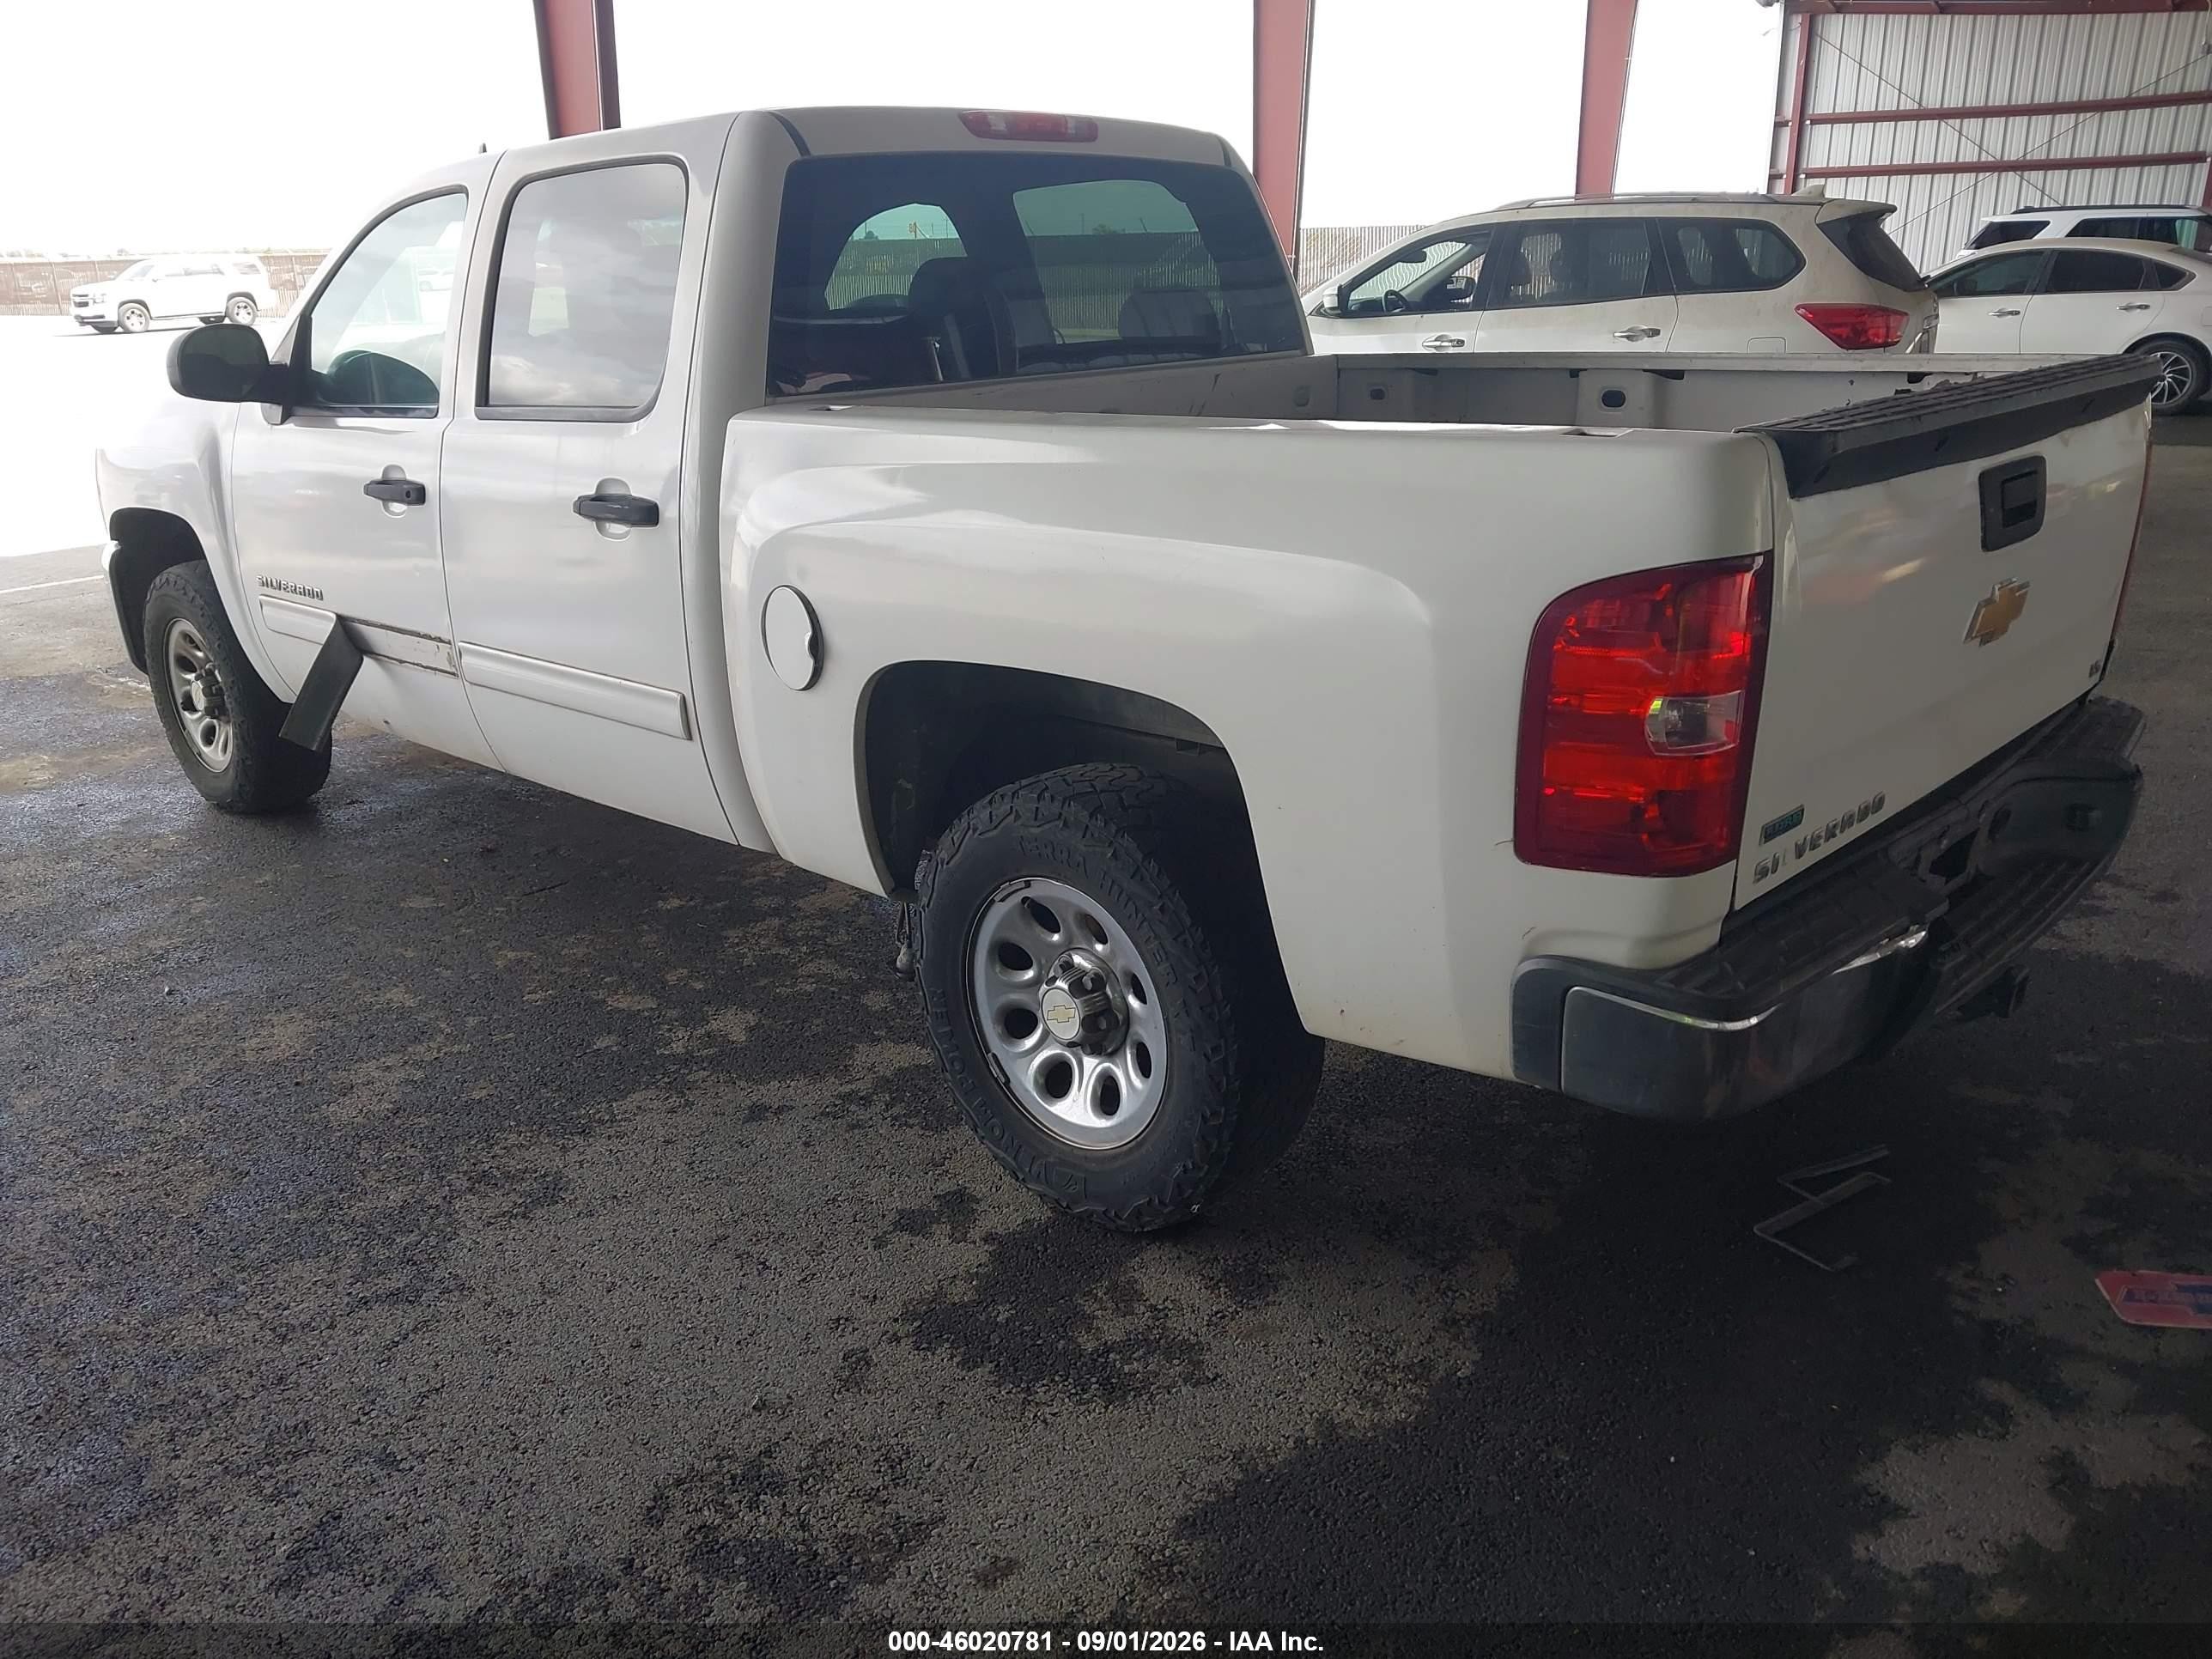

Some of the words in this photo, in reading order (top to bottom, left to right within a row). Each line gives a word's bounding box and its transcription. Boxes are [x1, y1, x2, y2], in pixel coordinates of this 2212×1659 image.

[256, 574, 324, 601] SILVERADO
[1014, 835, 1090, 879] TERRA
[1753, 792, 1886, 884] SIVERADO
